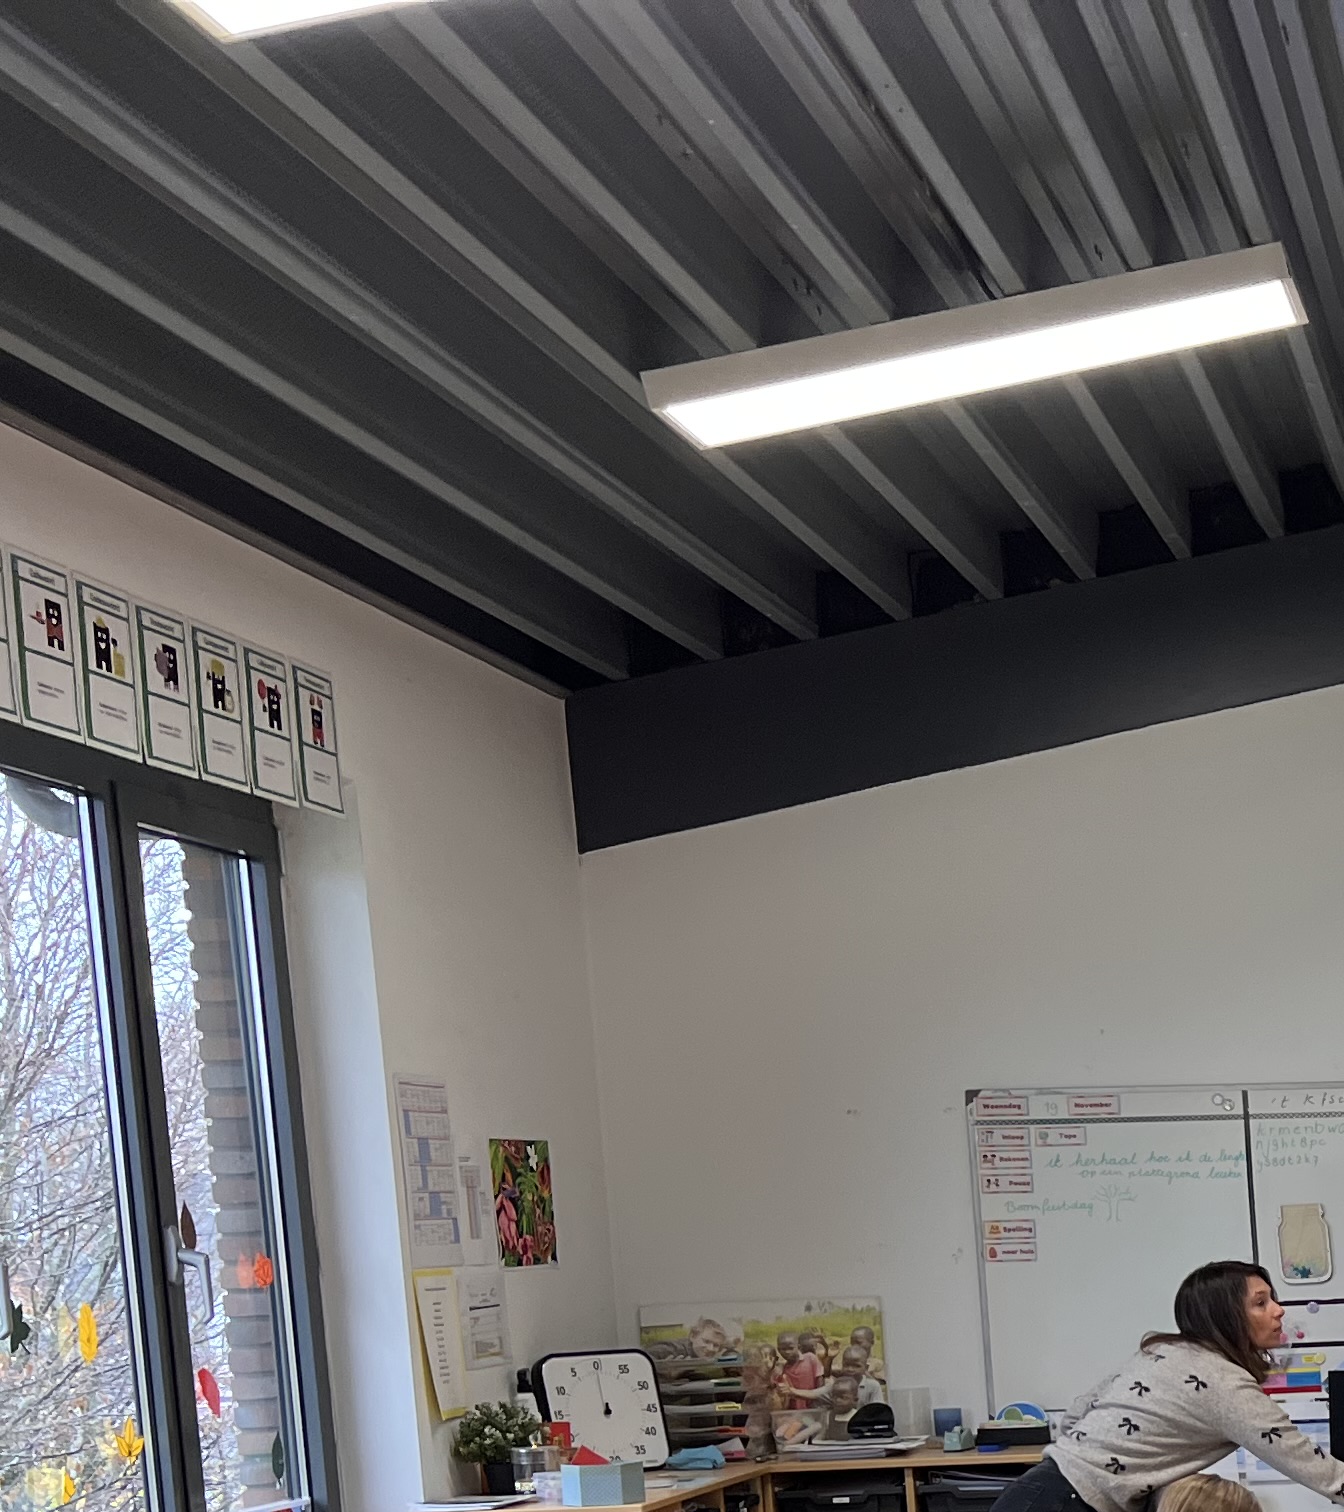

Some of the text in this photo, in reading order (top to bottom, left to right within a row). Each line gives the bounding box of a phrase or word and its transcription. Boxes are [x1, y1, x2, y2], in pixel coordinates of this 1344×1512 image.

[982, 1102, 1022, 1110] Woensdag
[1044, 1102, 1059, 1116] 19
[1074, 1101, 1113, 1109] November
[1058, 1132, 1077, 1140] Topo
[1199, 1150, 1213, 1163] de
[593, 1361, 599, 1371] 0
[618, 1364, 630, 1375] 55
[570, 1367, 577, 1378] 5
[637, 1380, 649, 1391] 50
[555, 1386, 566, 1396] 10
[646, 1403, 658, 1413] 45
[554, 1410, 564, 1420] 15
[644, 1426, 657, 1436] 40
[634, 1445, 647, 1455] 35
